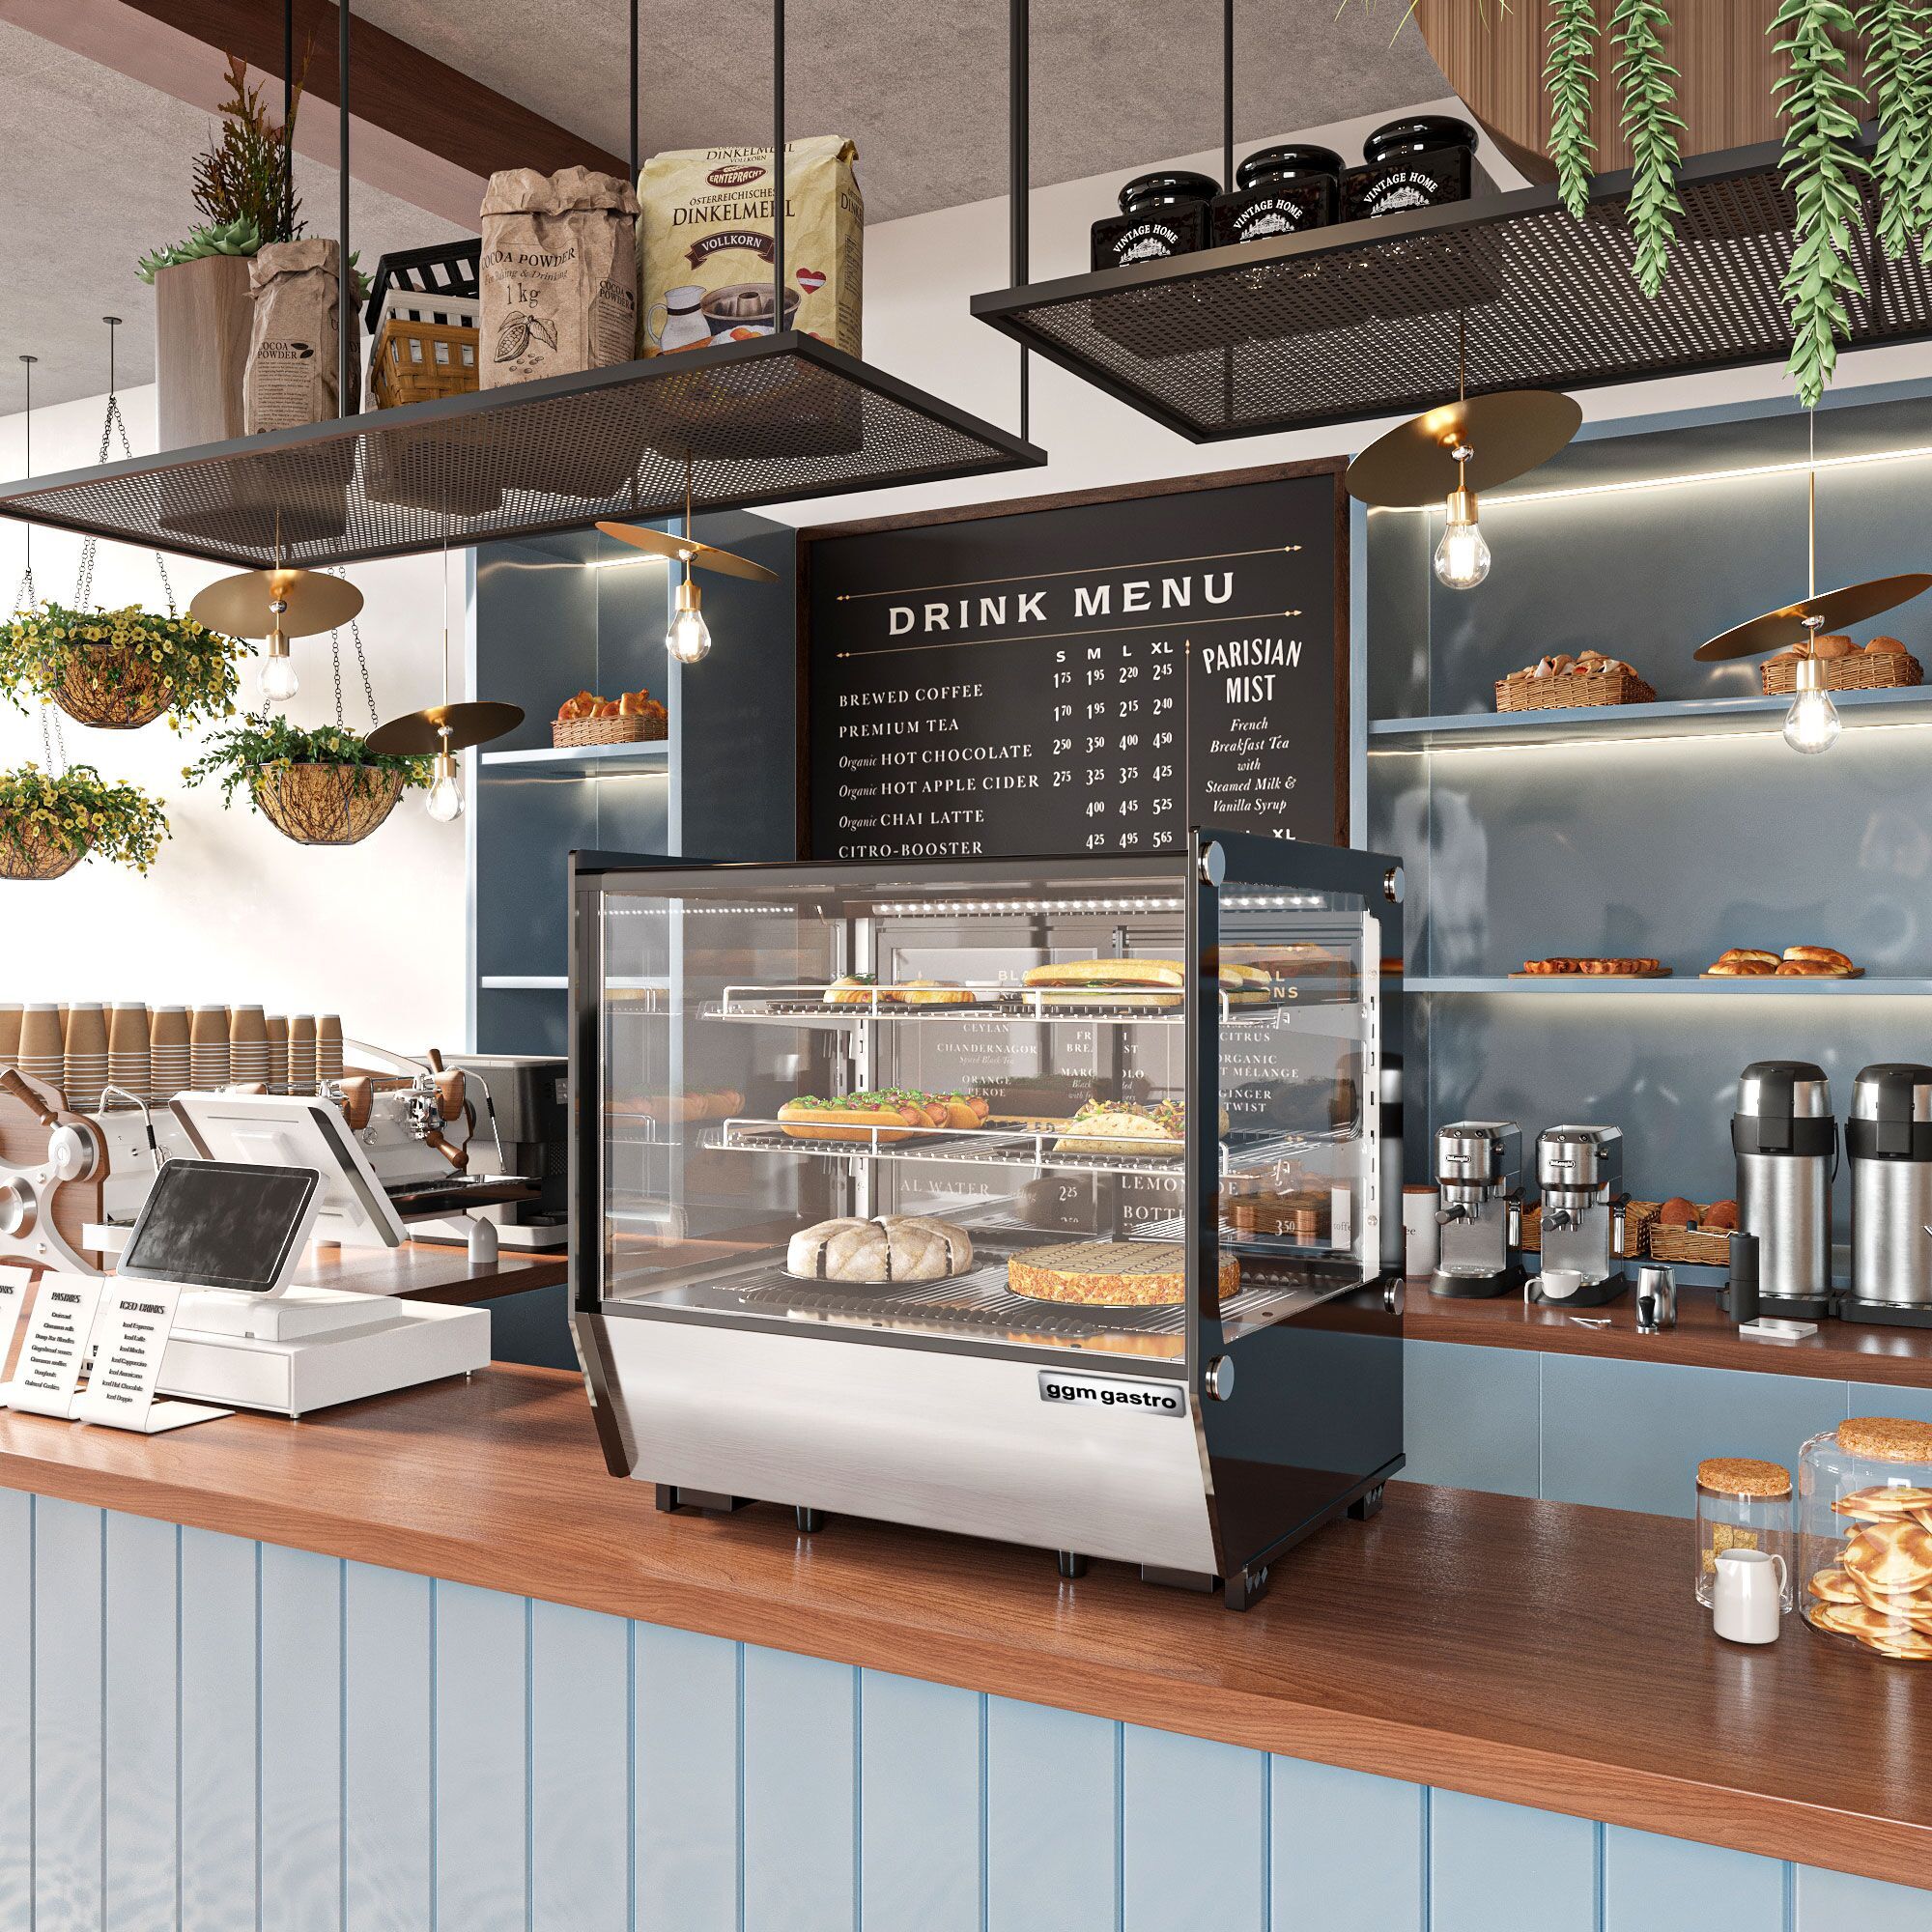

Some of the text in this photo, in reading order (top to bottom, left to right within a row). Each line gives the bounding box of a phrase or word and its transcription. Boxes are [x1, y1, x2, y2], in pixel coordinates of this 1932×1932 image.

[706, 143, 796, 160] DINKELMEL
[729, 155, 767, 163] VOLLKORN
[709, 169, 764, 184] ERNTEPRACHT
[1363, 172, 1438, 203] VINTAGE HOME
[1233, 198, 1303, 229] VINTAGE HOME
[701, 235, 763, 252] VOLLKORN
[1113, 223, 1179, 253] VINTAGE HOME
[481, 247, 576, 270] COCOA POWDER
[531, 270, 568, 281] Drinking
[506, 282, 541, 308] 1 kg
[599, 280, 625, 297] COCOA
[599, 288, 630, 309] POWDER
[257, 351, 298, 359] POWDER
[889, 572, 1235, 635] DRINK MENU
[1056, 641, 1174, 663] S M L XL
[1202, 638, 1302, 674] PARISIAN
[839, 690, 909, 707] BREWED
[915, 684, 983, 701] COFFEE
[1226, 674, 1276, 703] MIST
[838, 721, 920, 738] PREMIUM
[925, 718, 959, 732] TEA
[1230, 717, 1268, 731] French
[1209, 734, 1290, 755] Breakfast Tea
[838, 754, 877, 771] Organic
[881, 751, 918, 766] HOT
[922, 744, 1033, 763] CHOCOLATE
[1236, 757, 1262, 771] with
[838, 783, 877, 800] Organic
[881, 781, 918, 795] HOT
[922, 778, 977, 793] APPLE
[982, 775, 1039, 790] CIDER
[1206, 776, 1297, 793] Steamed Milk &
[1213, 798, 1288, 815] Vanilla Syrup
[838, 814, 877, 831] Organic
[880, 811, 923, 826] CHAI
[930, 810, 984, 825] LATTE
[1272, 829, 1296, 840] XL
[838, 841, 983, 859] CITRO-BOOSTER
[963, 1023, 1009, 1033] CEYLAN
[1220, 1032, 1270, 1042] CITRUS
[936, 1042, 1037, 1054] CHANDERNAGOR
[961, 1074, 1012, 1085] ORANGE
[1234, 1066, 1299, 1078] MÉLANGE
[968, 1088, 1007, 1097] PEKOE
[1218, 1089, 1272, 1099] GINGER
[1224, 1101, 1266, 1113] TWIST
[929, 1179, 990, 1197] WATER
[119, 1300, 165, 1314] ICED DRINKS
[1046, 1383, 1177, 1409] ggm gastro
